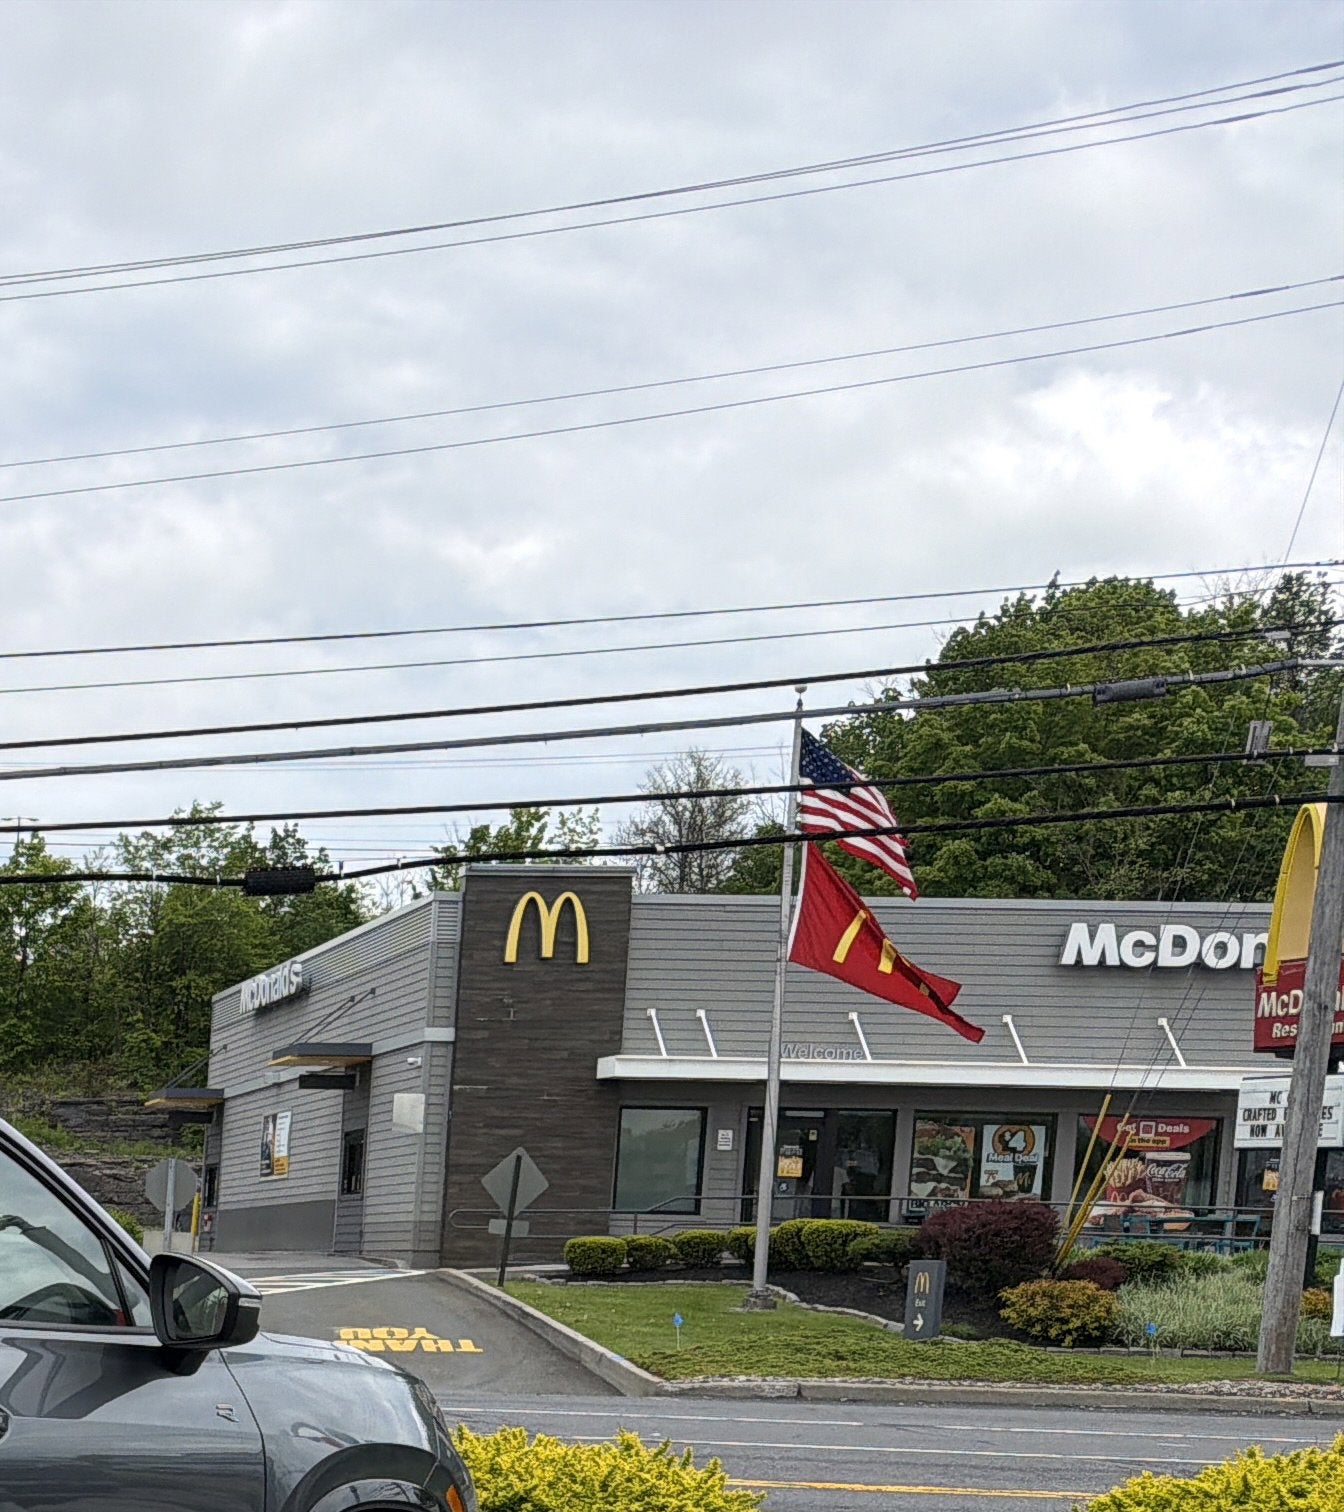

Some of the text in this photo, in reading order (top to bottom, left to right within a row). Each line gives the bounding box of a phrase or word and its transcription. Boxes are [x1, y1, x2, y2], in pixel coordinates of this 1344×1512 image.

[781, 1043, 863, 1060] Welcome
[1243, 1107, 1276, 1122] CRAFTED
[1157, 1123, 1190, 1134] Deals
[1250, 1124, 1268, 1137] NOW
[340, 1327, 440, 1339] YOU
